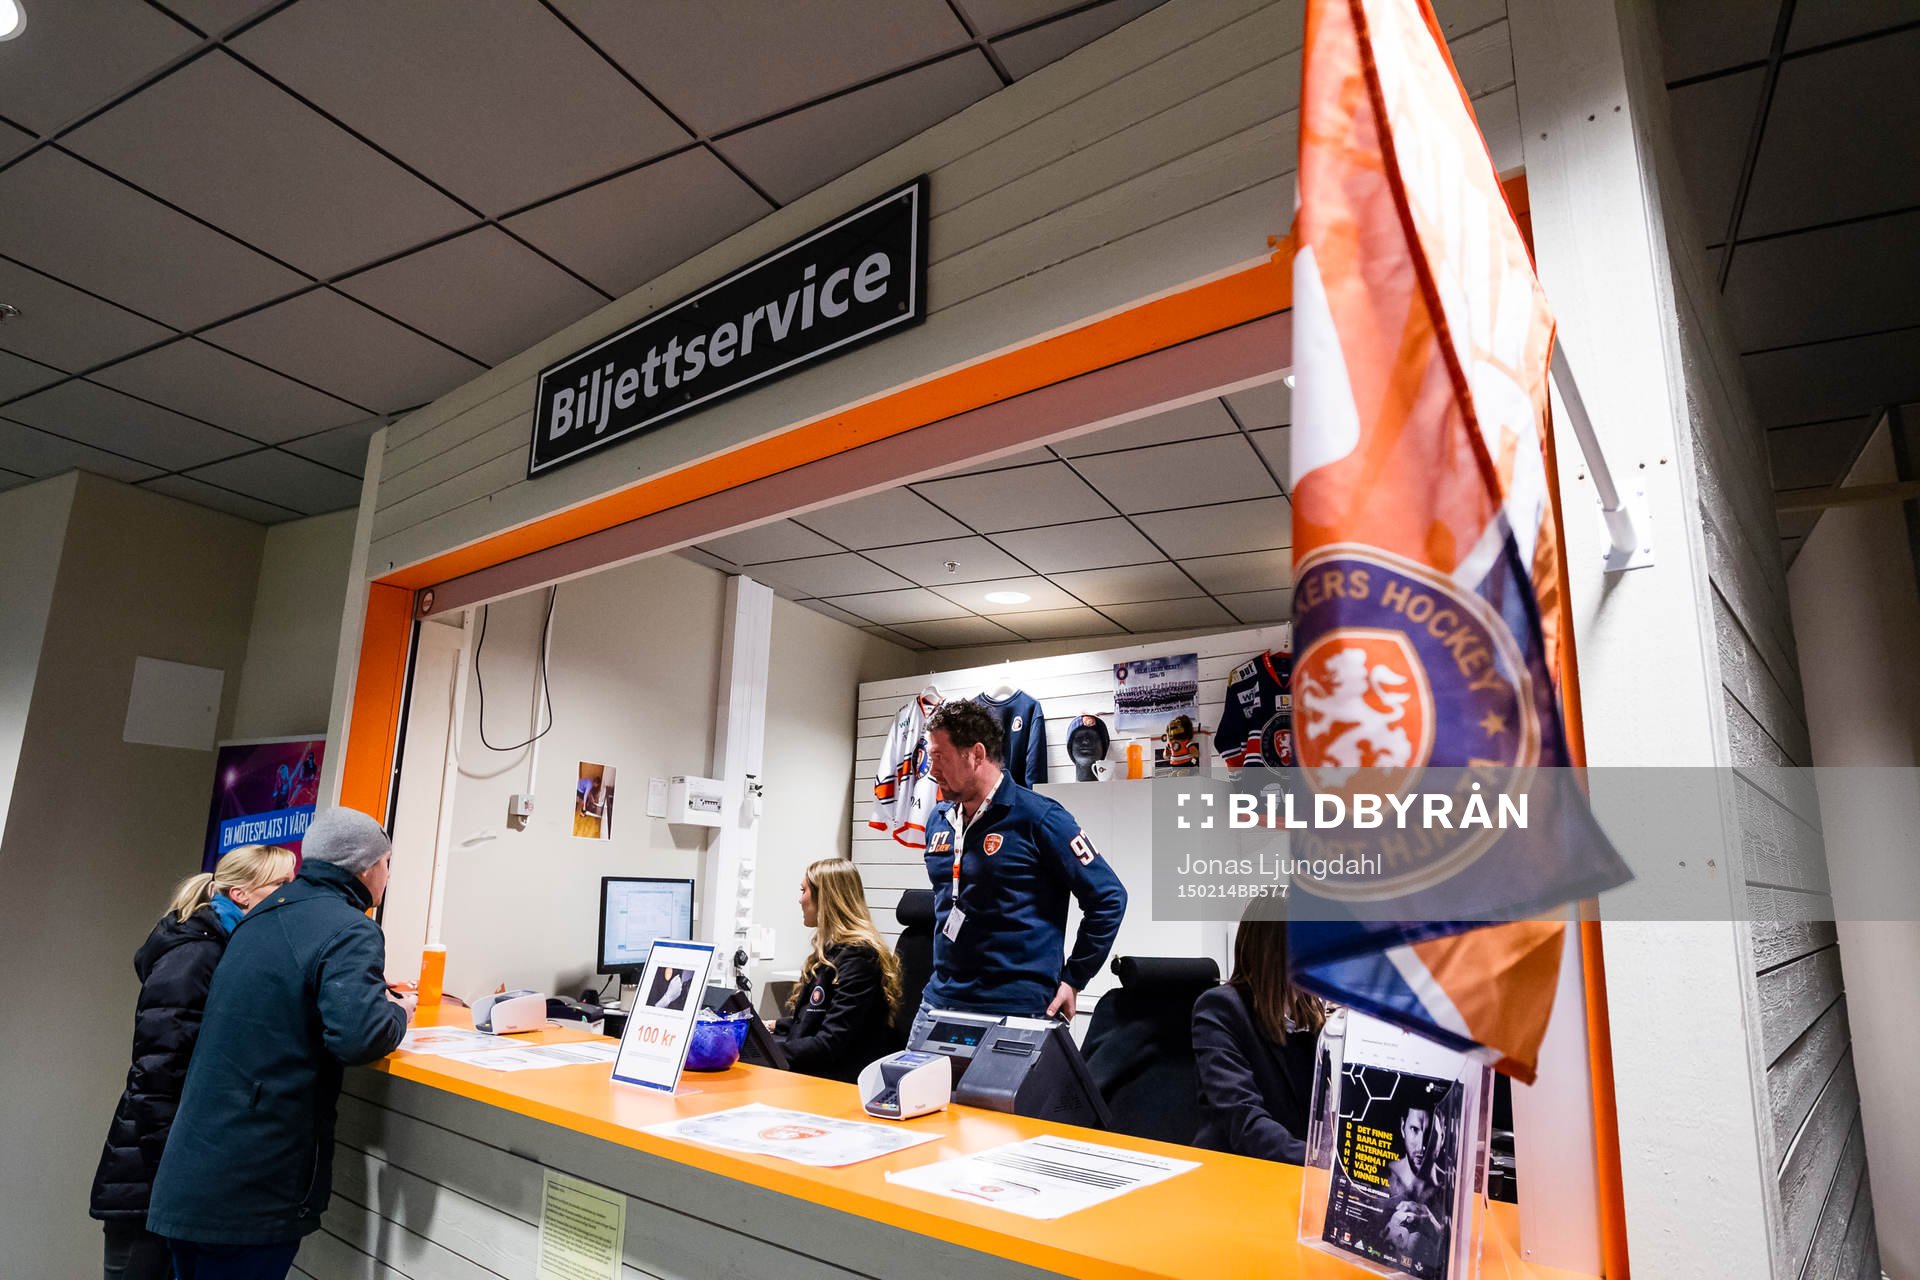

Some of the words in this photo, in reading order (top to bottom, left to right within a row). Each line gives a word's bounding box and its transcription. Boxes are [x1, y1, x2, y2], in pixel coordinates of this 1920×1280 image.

[549, 251, 891, 440] Biljettservice
[1380, 580, 1505, 692] HOCKEY
[224, 827, 234, 847] EN
[233, 818, 282, 844] MÖTESPLATS
[284, 816, 289, 836] I
[638, 1025, 659, 1043] 100
[661, 1029, 677, 1047] kr
[1357, 1126, 1371, 1135] DET
[1372, 1128, 1393, 1140] FINNS
[1356, 1134, 1377, 1146] BARA
[1378, 1139, 1392, 1149] ETT
[1355, 1152, 1381, 1165] HEMMA
[1356, 1143, 1400, 1161] ALTERNATIV.
[1354, 1160, 1377, 1174] VÄXJÖ
[1353, 1169, 1380, 1184] VINNER
